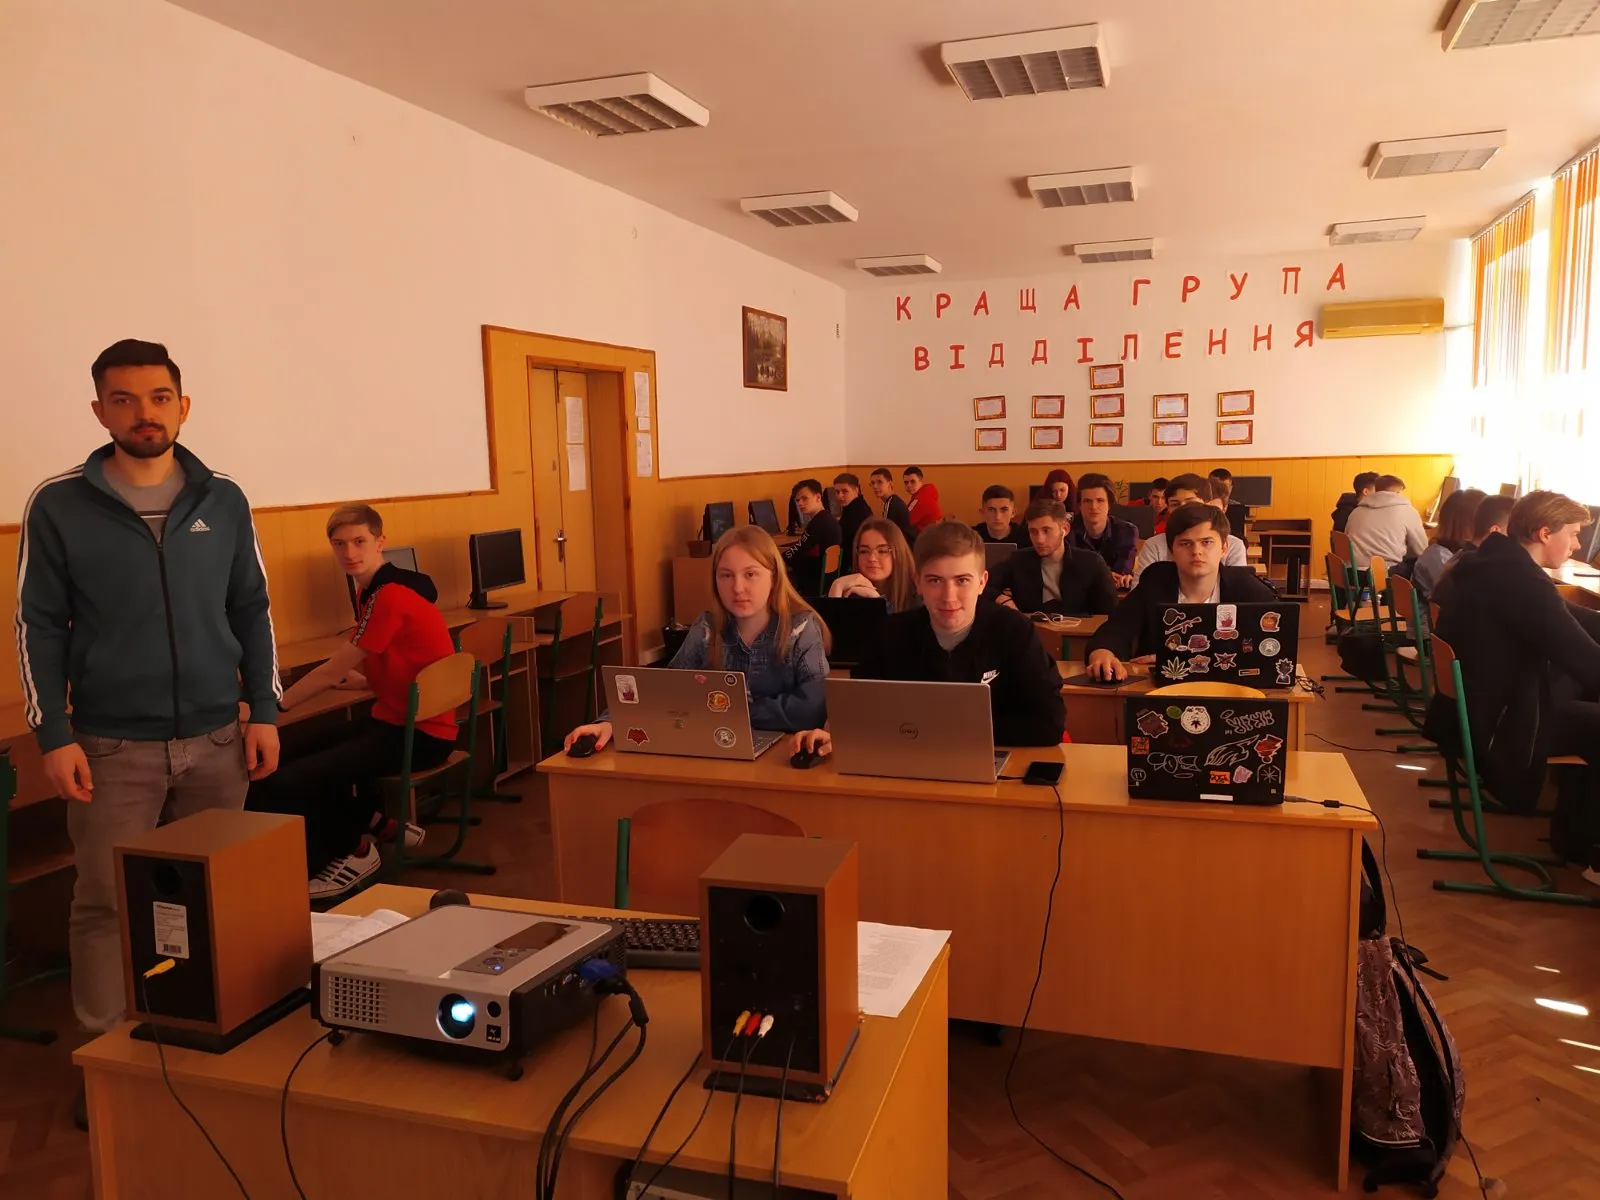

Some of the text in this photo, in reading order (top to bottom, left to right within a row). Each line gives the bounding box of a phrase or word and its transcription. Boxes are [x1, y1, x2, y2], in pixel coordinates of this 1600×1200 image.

[896, 262, 1347, 321] КРАЩА ГРУПА
[913, 319, 1314, 371] ВІДДІЛЕННЯ
